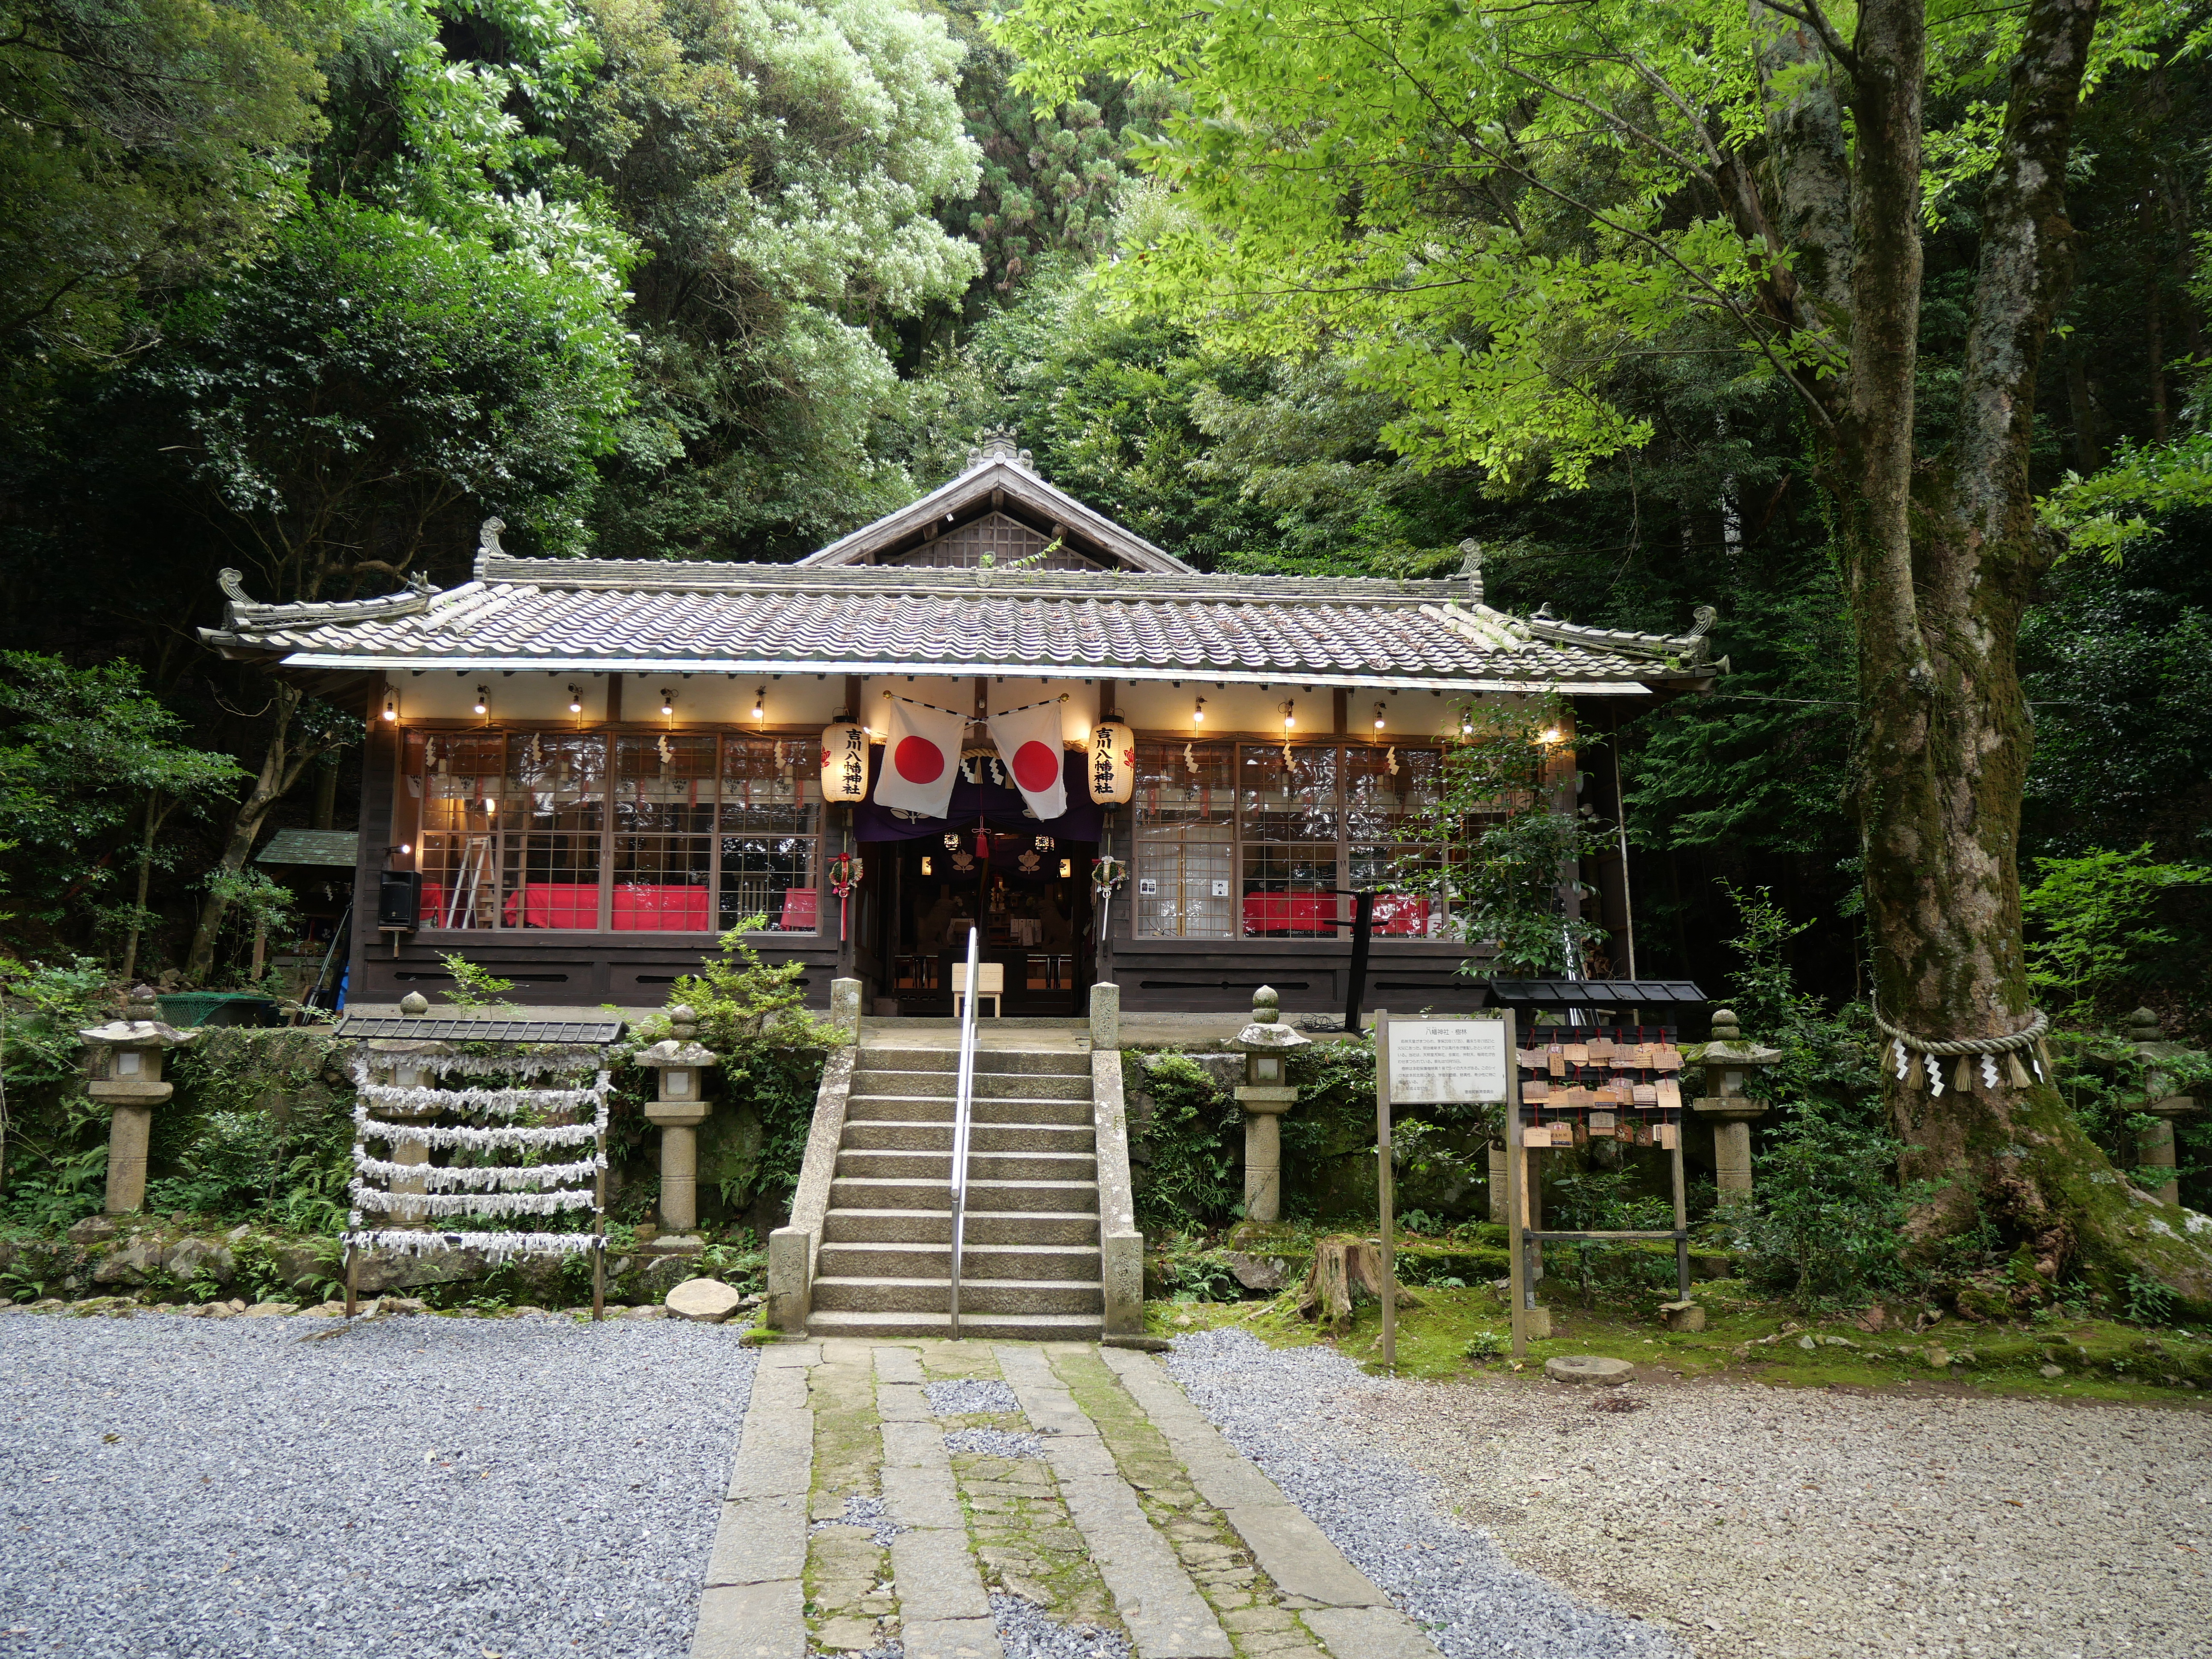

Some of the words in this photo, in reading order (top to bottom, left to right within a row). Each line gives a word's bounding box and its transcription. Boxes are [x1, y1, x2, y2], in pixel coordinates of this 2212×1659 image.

[841, 728, 862, 795] 吉川八幡神社
[1094, 727, 1114, 794] 吉川八幡神社
